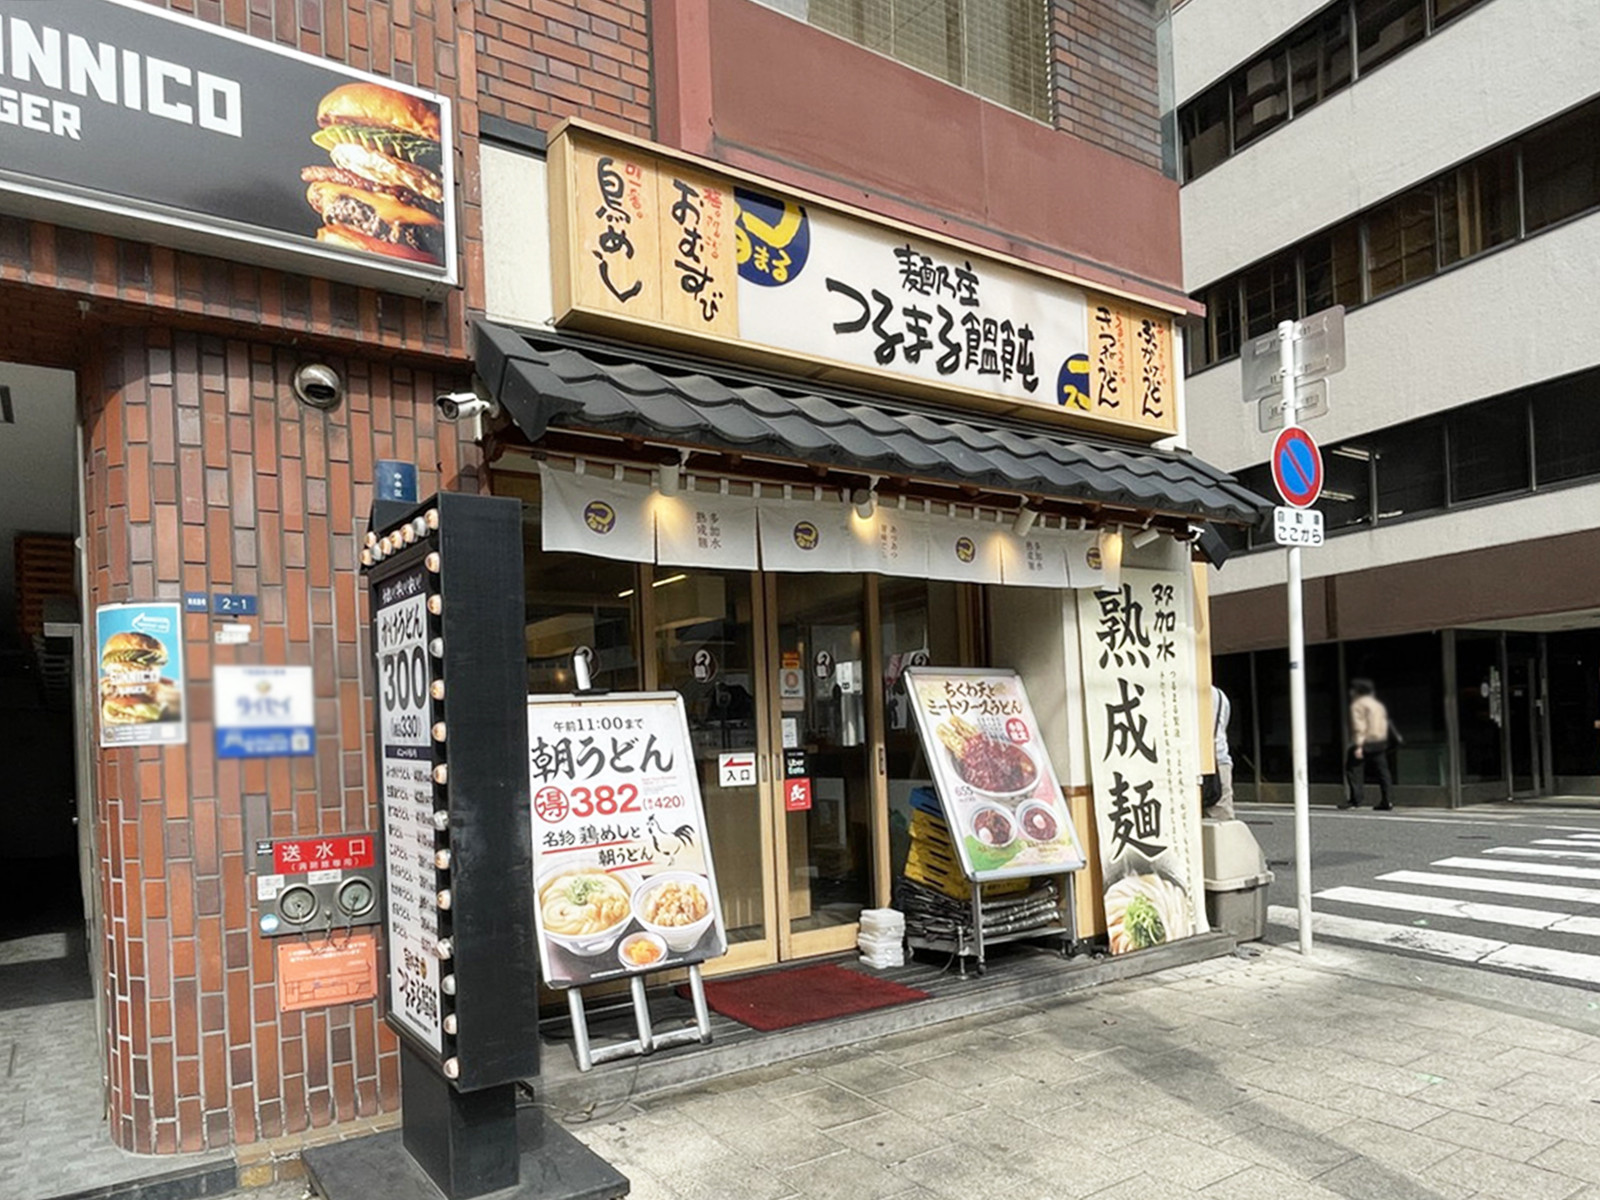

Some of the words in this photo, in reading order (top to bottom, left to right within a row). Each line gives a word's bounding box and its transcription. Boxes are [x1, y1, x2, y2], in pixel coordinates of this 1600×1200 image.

[0, 13, 242, 138] NNICO
[671, 178, 724, 322] おむすび
[825, 277, 1039, 393] つるまる饂飩
[1278, 526, 1321, 544] ここから
[222, 597, 248, 610] 2-1
[384, 645, 427, 713] 300
[943, 680, 997, 699] ちくわ天と
[553, 716, 645, 733] 午前11:00まで
[1093, 583, 1168, 861] 熟成麺
[531, 734, 674, 784] 朝うどん
[725, 769, 751, 782] 入口
[569, 783, 641, 818] 382
[282, 838, 366, 863] 送水口
[597, 846, 654, 867] 朝うどん
